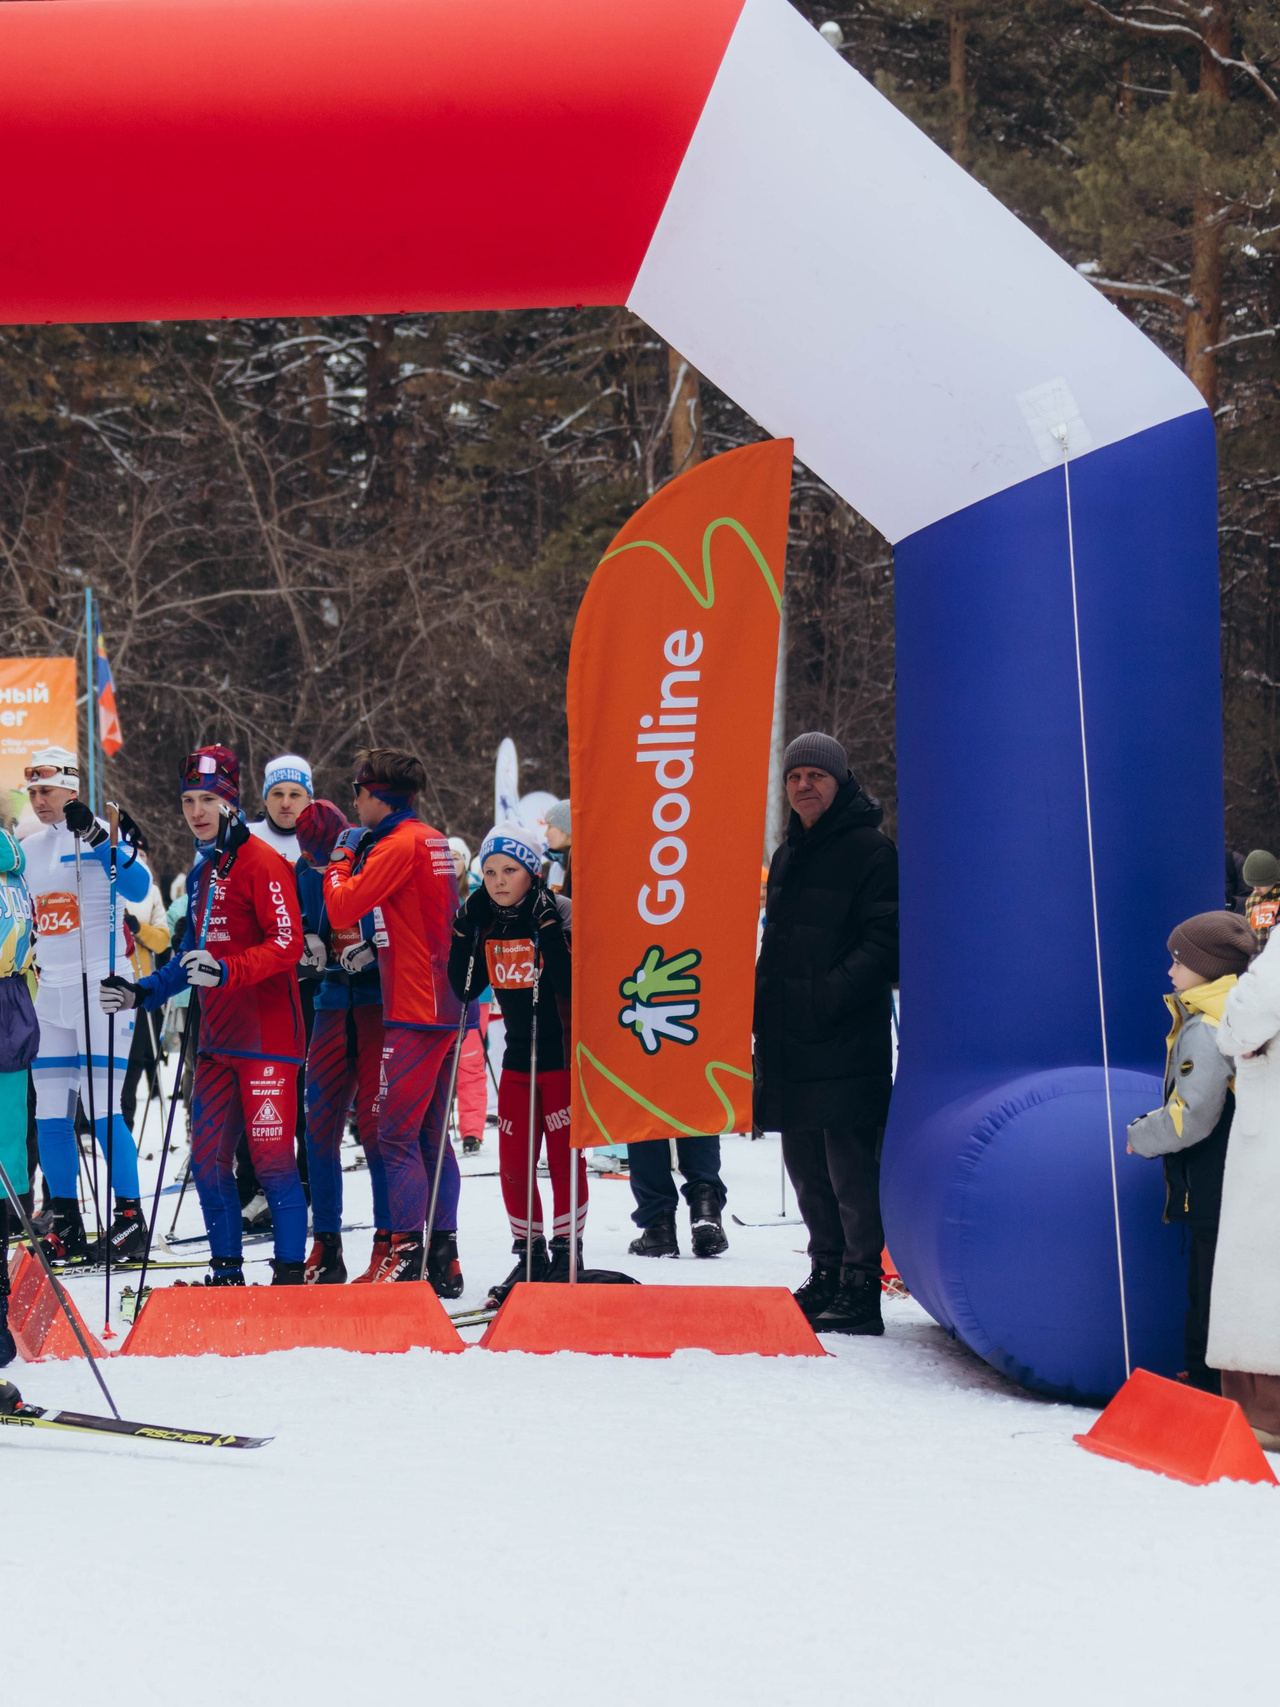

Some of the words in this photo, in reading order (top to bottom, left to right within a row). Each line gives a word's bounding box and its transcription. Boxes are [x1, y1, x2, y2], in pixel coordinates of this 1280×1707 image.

[636, 628, 704, 926] Goodline
[40, 912, 73, 932] 034
[269, 881, 293, 949] КУЗБАСС
[495, 962, 535, 984] 042
[252, 1126, 282, 1137] БЕРЛОГА
[111, 1222, 139, 1246] MADSHUS
[135, 1427, 212, 1445] FISCHER
